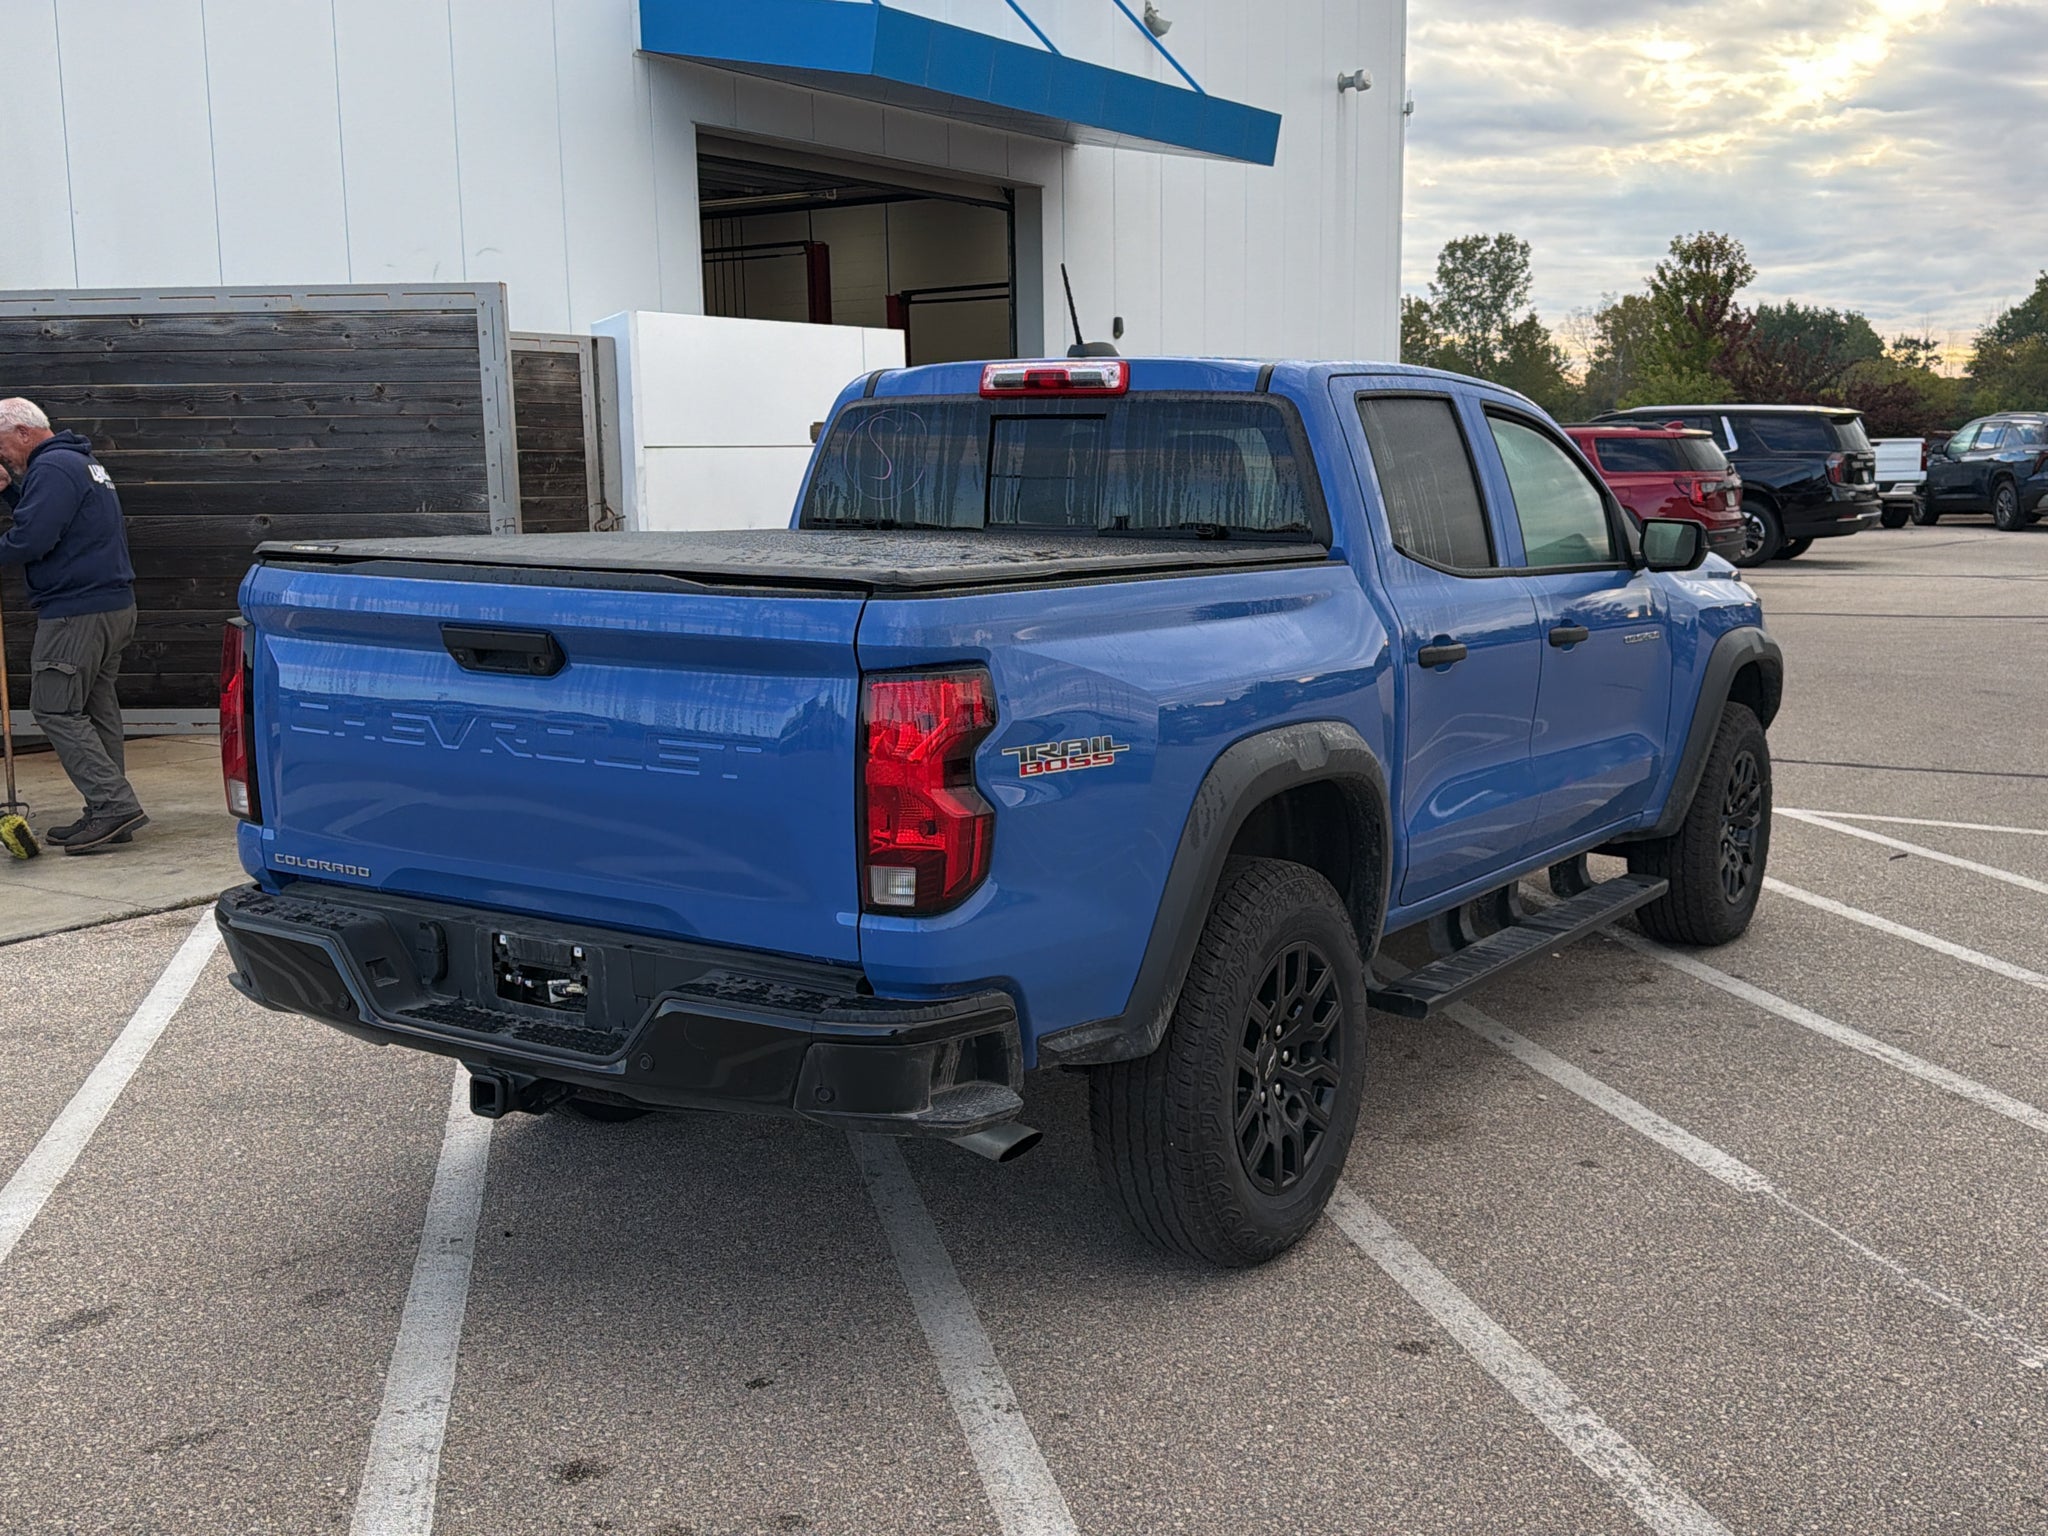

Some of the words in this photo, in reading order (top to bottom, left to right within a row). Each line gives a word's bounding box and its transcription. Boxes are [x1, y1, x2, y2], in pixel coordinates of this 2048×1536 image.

[1002, 735, 1130, 763] TRAIL
[1019, 751, 1115, 778] BOSS
[274, 853, 371, 878] COLORADO
